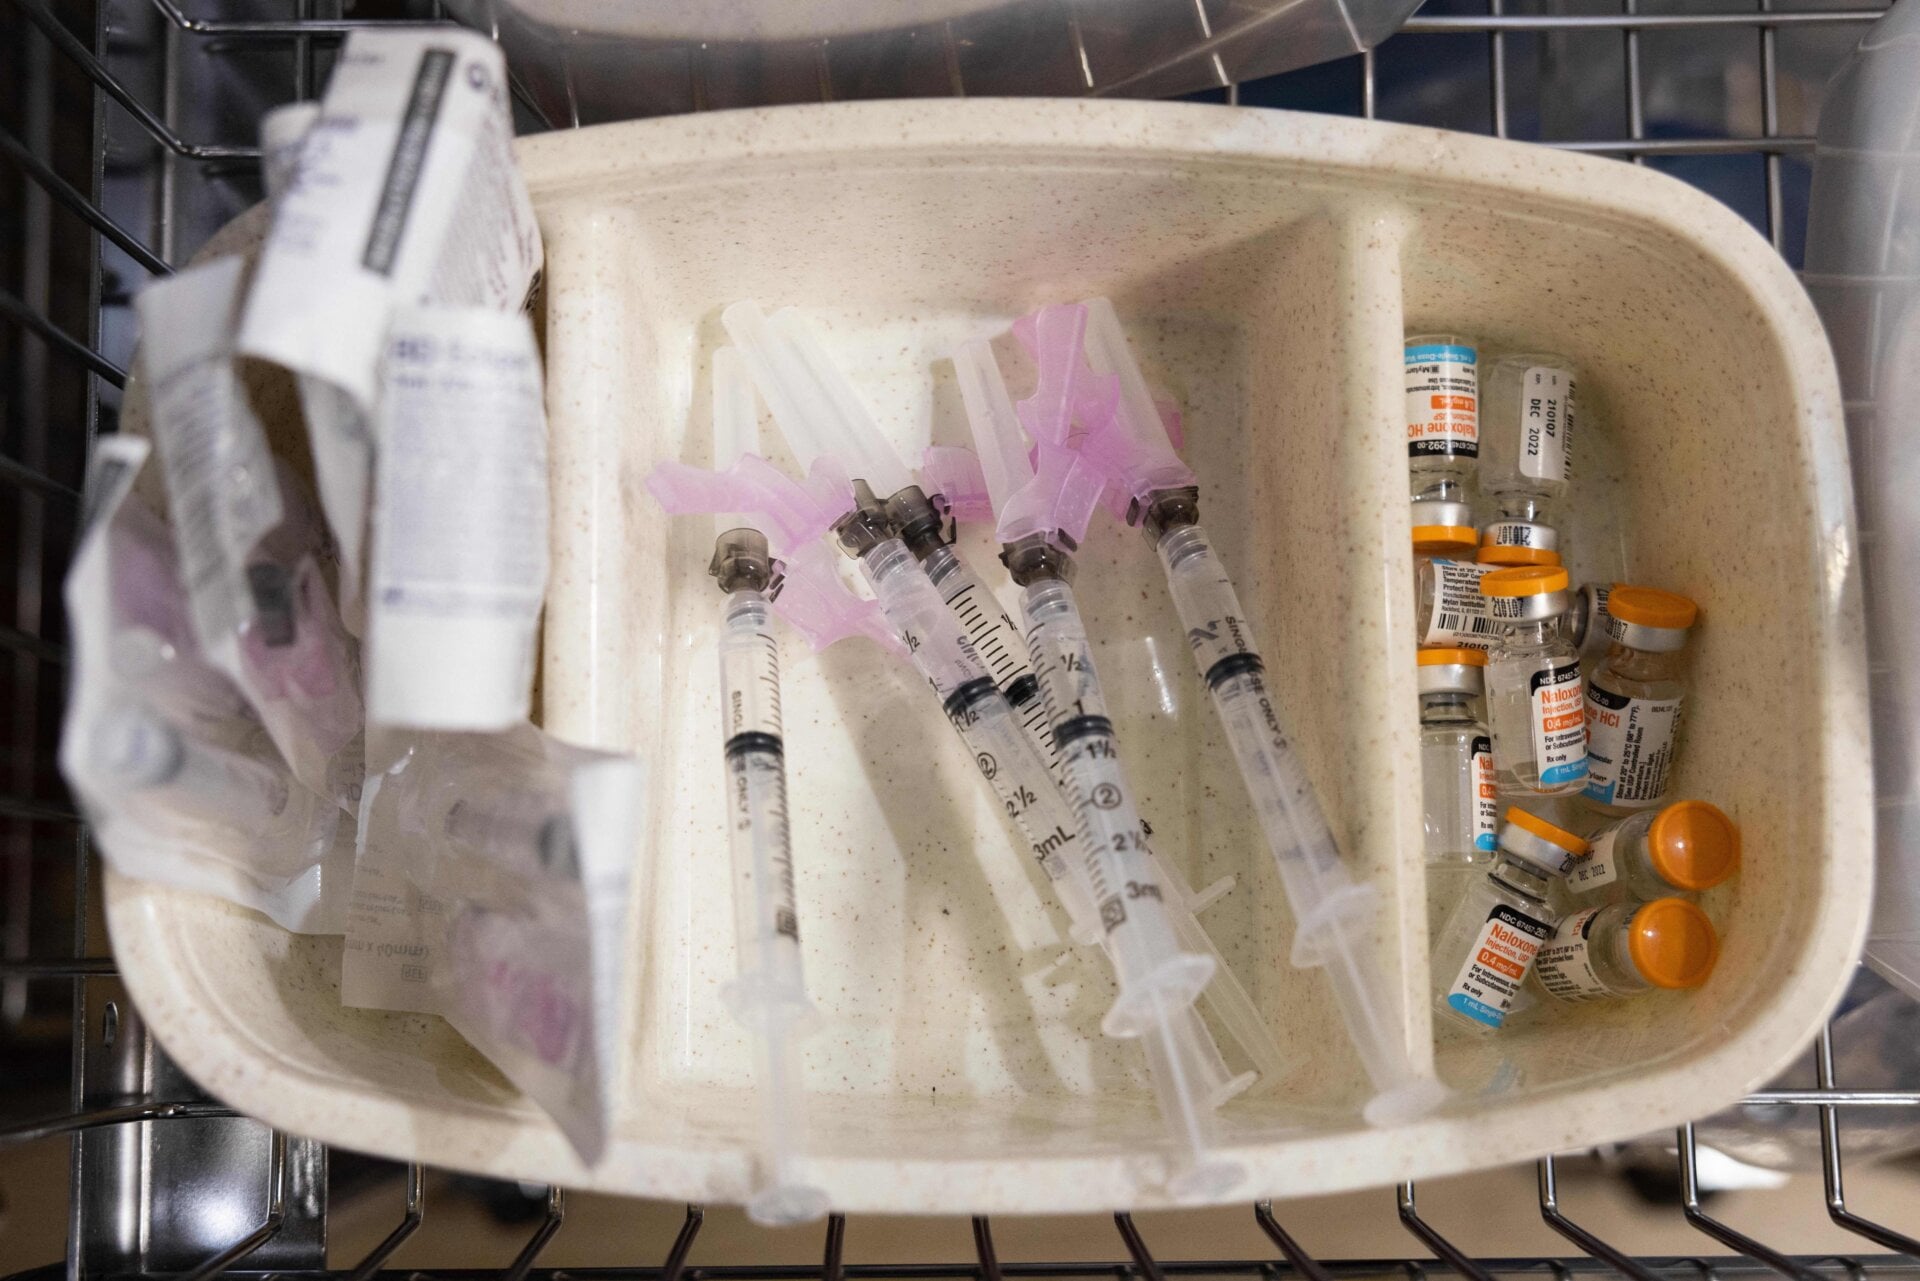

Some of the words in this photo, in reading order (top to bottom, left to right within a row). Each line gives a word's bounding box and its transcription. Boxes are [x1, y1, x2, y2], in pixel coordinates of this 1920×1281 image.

[1529, 398, 1541, 418] DEC
[1546, 399, 1557, 438] 210107
[1527, 428, 1540, 456] 2022
[1259, 698, 1282, 734] ONLY
[1032, 825, 1076, 862] 3mL
[1578, 870, 1589, 881] DEC
[1499, 911, 1517, 924] NDC
[1485, 937, 1518, 960] Injection,
[1481, 951, 1497, 967] 0.4
[1471, 963, 1482, 974] For
[1462, 982, 1471, 991] Rx
[1471, 987, 1483, 998] only
[1468, 1000, 1479, 1010] mL
